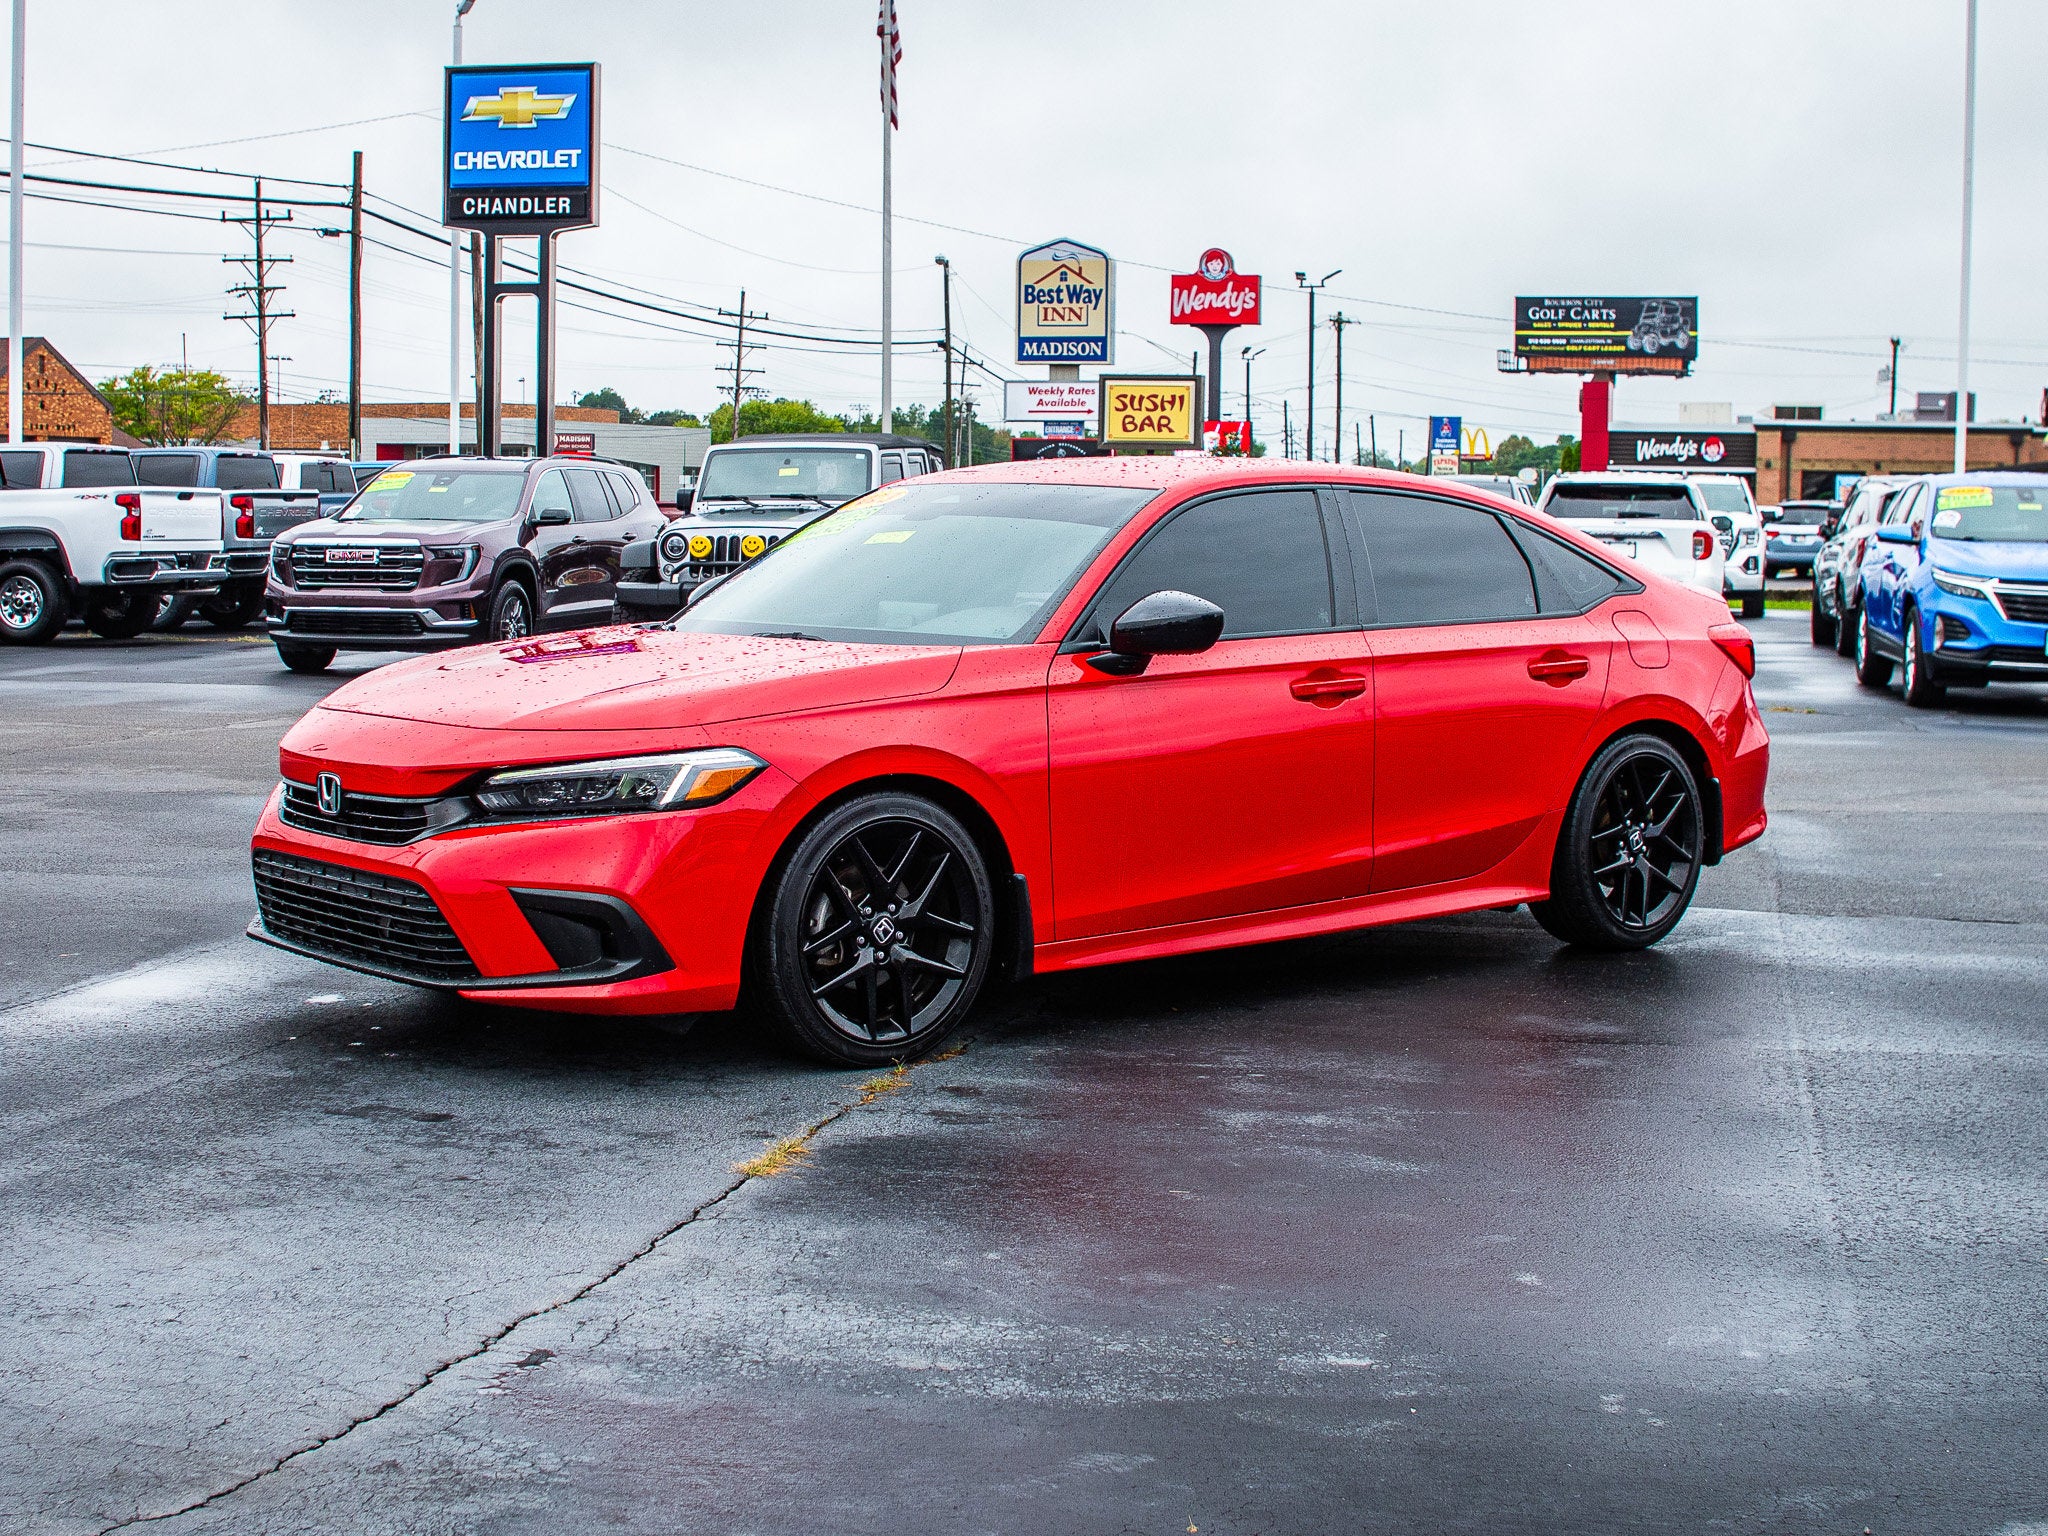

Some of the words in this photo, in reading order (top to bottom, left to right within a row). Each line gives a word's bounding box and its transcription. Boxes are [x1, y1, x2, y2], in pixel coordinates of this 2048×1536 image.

[454, 149, 582, 170] CHEVROLET
[463, 197, 571, 215] CHANDLER
[1024, 284, 1064, 304] Best
[1065, 284, 1103, 310] Way
[1173, 281, 1257, 317] Wendy's
[1042, 307, 1084, 321] INN
[1528, 307, 1566, 320] GOLF
[1570, 307, 1616, 320] CARTS
[1022, 342, 1102, 356] MADISON
[1028, 387, 1066, 397] Weekly
[1068, 386, 1096, 395] Rates
[1036, 399, 1087, 407] Available
[1115, 394, 1186, 412] SUSHI
[1122, 415, 1175, 433] BAR
[1636, 435, 1698, 462] Wendy's
[329, 550, 375, 560] GMC
